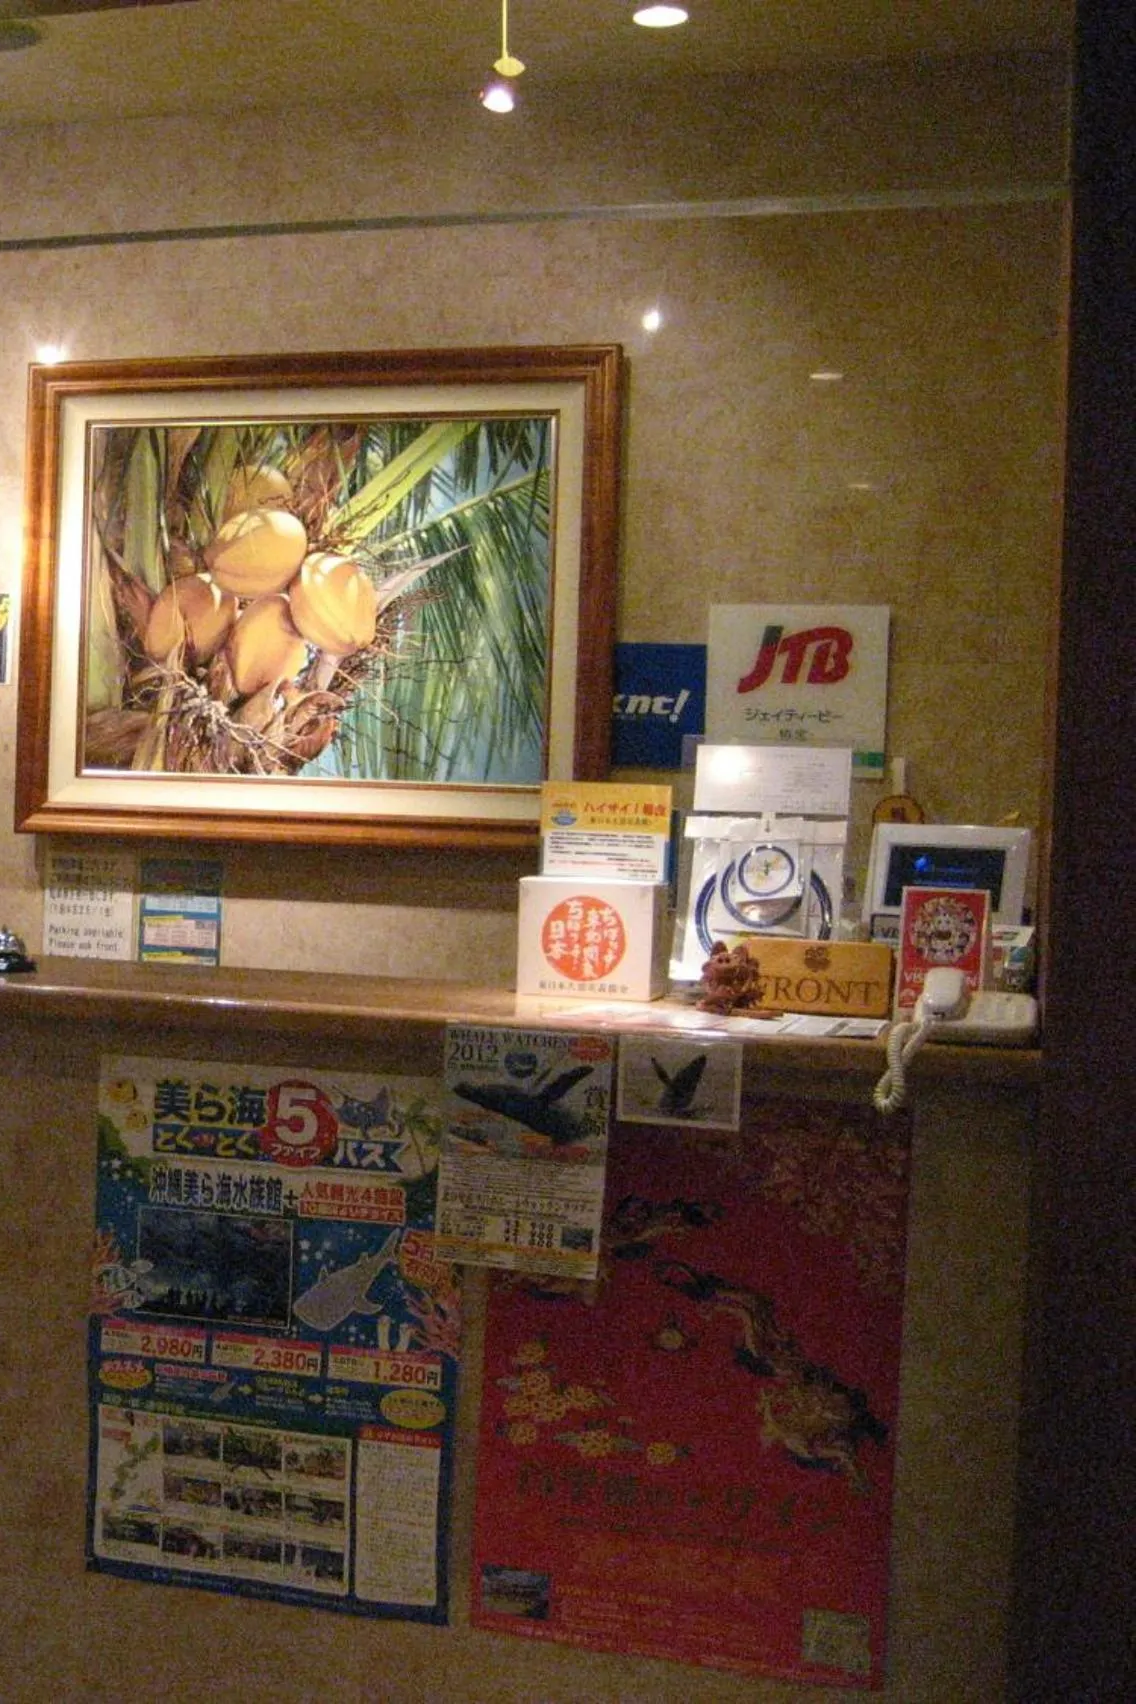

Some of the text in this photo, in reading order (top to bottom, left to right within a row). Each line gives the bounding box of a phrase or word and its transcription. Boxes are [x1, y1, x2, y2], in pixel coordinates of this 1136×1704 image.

[737, 624, 853, 693] JTB
[744, 707, 843, 723] ジェイティービー
[449, 1041, 499, 1062] 2012
[155, 1079, 319, 1145] 美ら海 5
